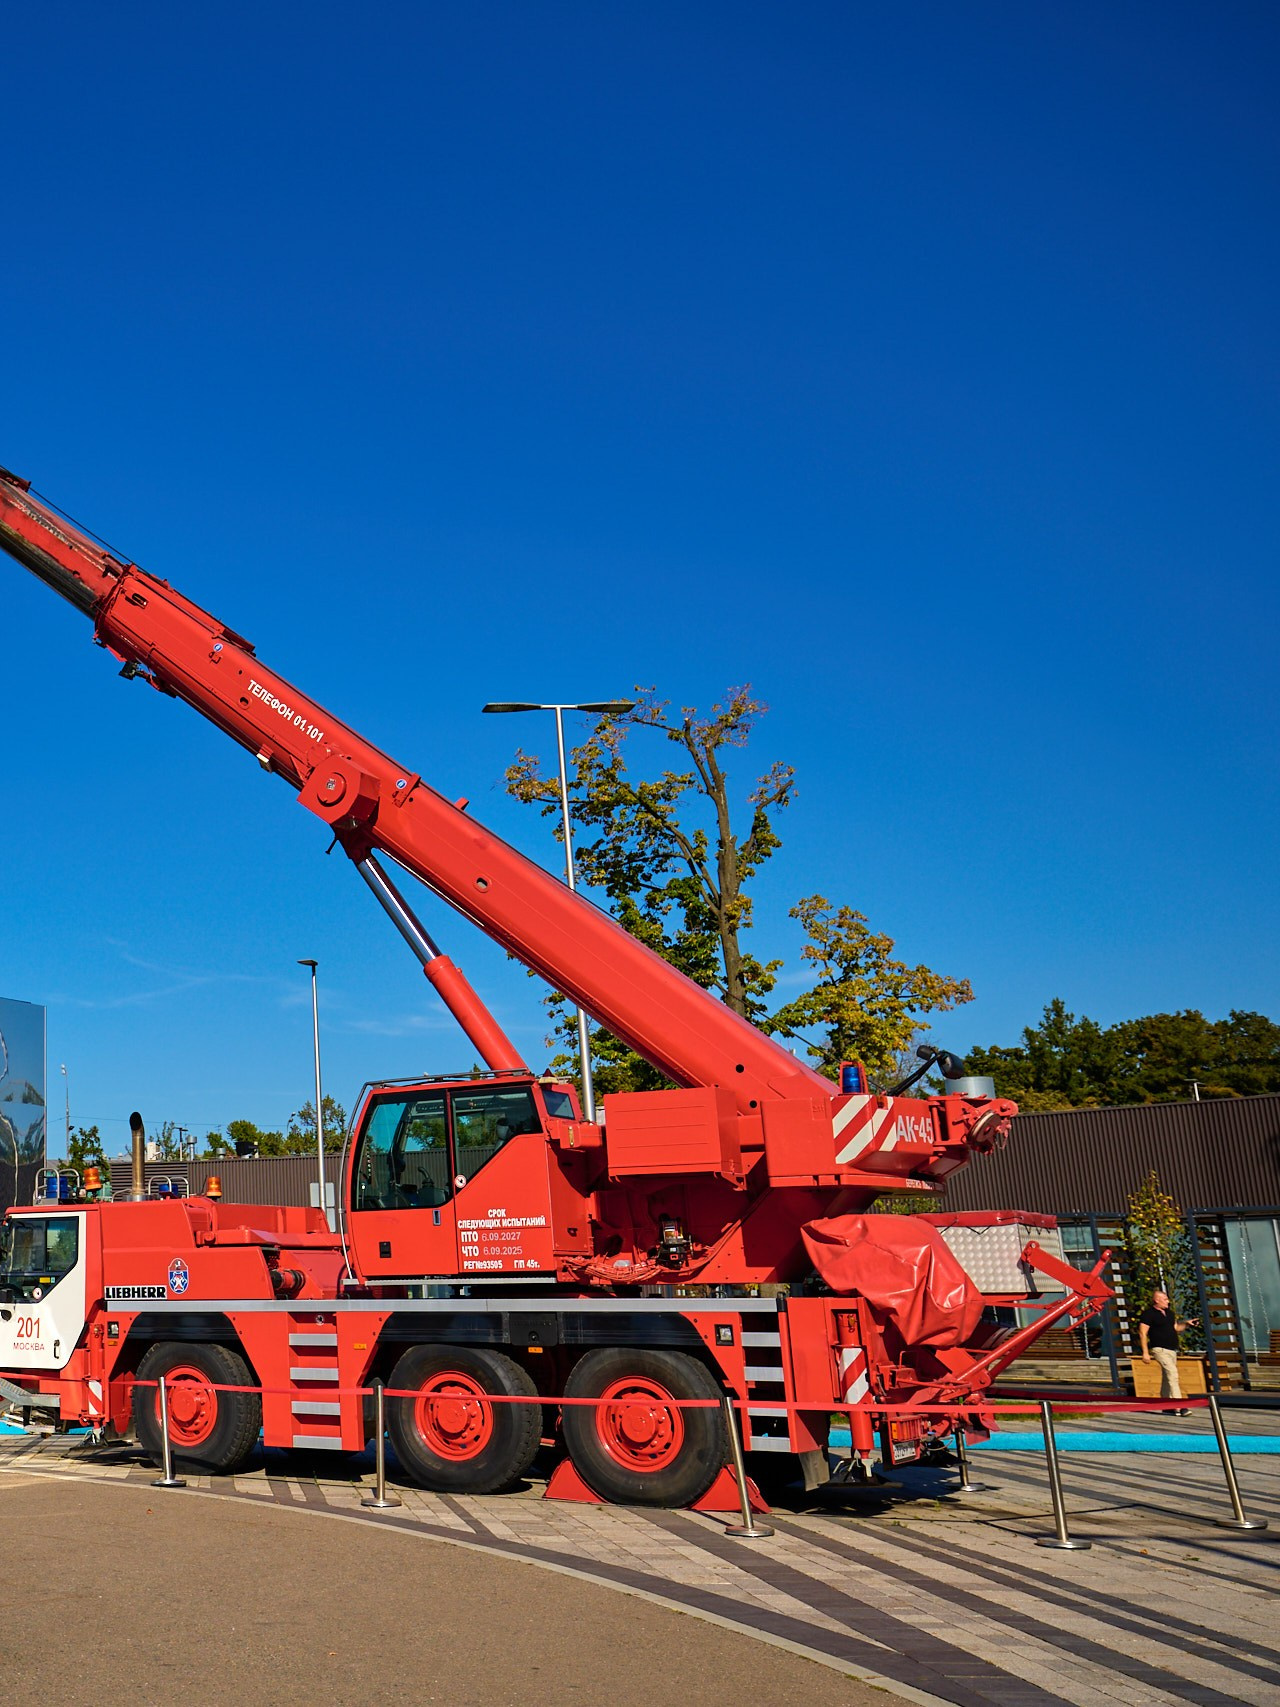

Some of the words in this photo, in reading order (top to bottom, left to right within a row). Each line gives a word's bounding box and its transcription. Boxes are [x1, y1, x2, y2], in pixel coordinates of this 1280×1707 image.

[247, 680, 295, 721] ТЕЛЕФОН
[897, 1115, 934, 1144] АК-45
[488, 1209, 506, 1218] СРОК
[458, 1219, 501, 1229] СЛЕДУЮЩИХ
[502, 1215, 546, 1227] ИСПЫТАНИЙ
[461, 1231, 478, 1242] ПТО
[481, 1232, 521, 1241] 6.09.2027
[462, 1246, 479, 1256] ЧТО
[483, 1246, 523, 1255] 6.09.2025
[105, 1286, 166, 1298] LIEBHERR
[16, 1316, 41, 1338] 201
[13, 1342, 45, 1350] МОСКВА
